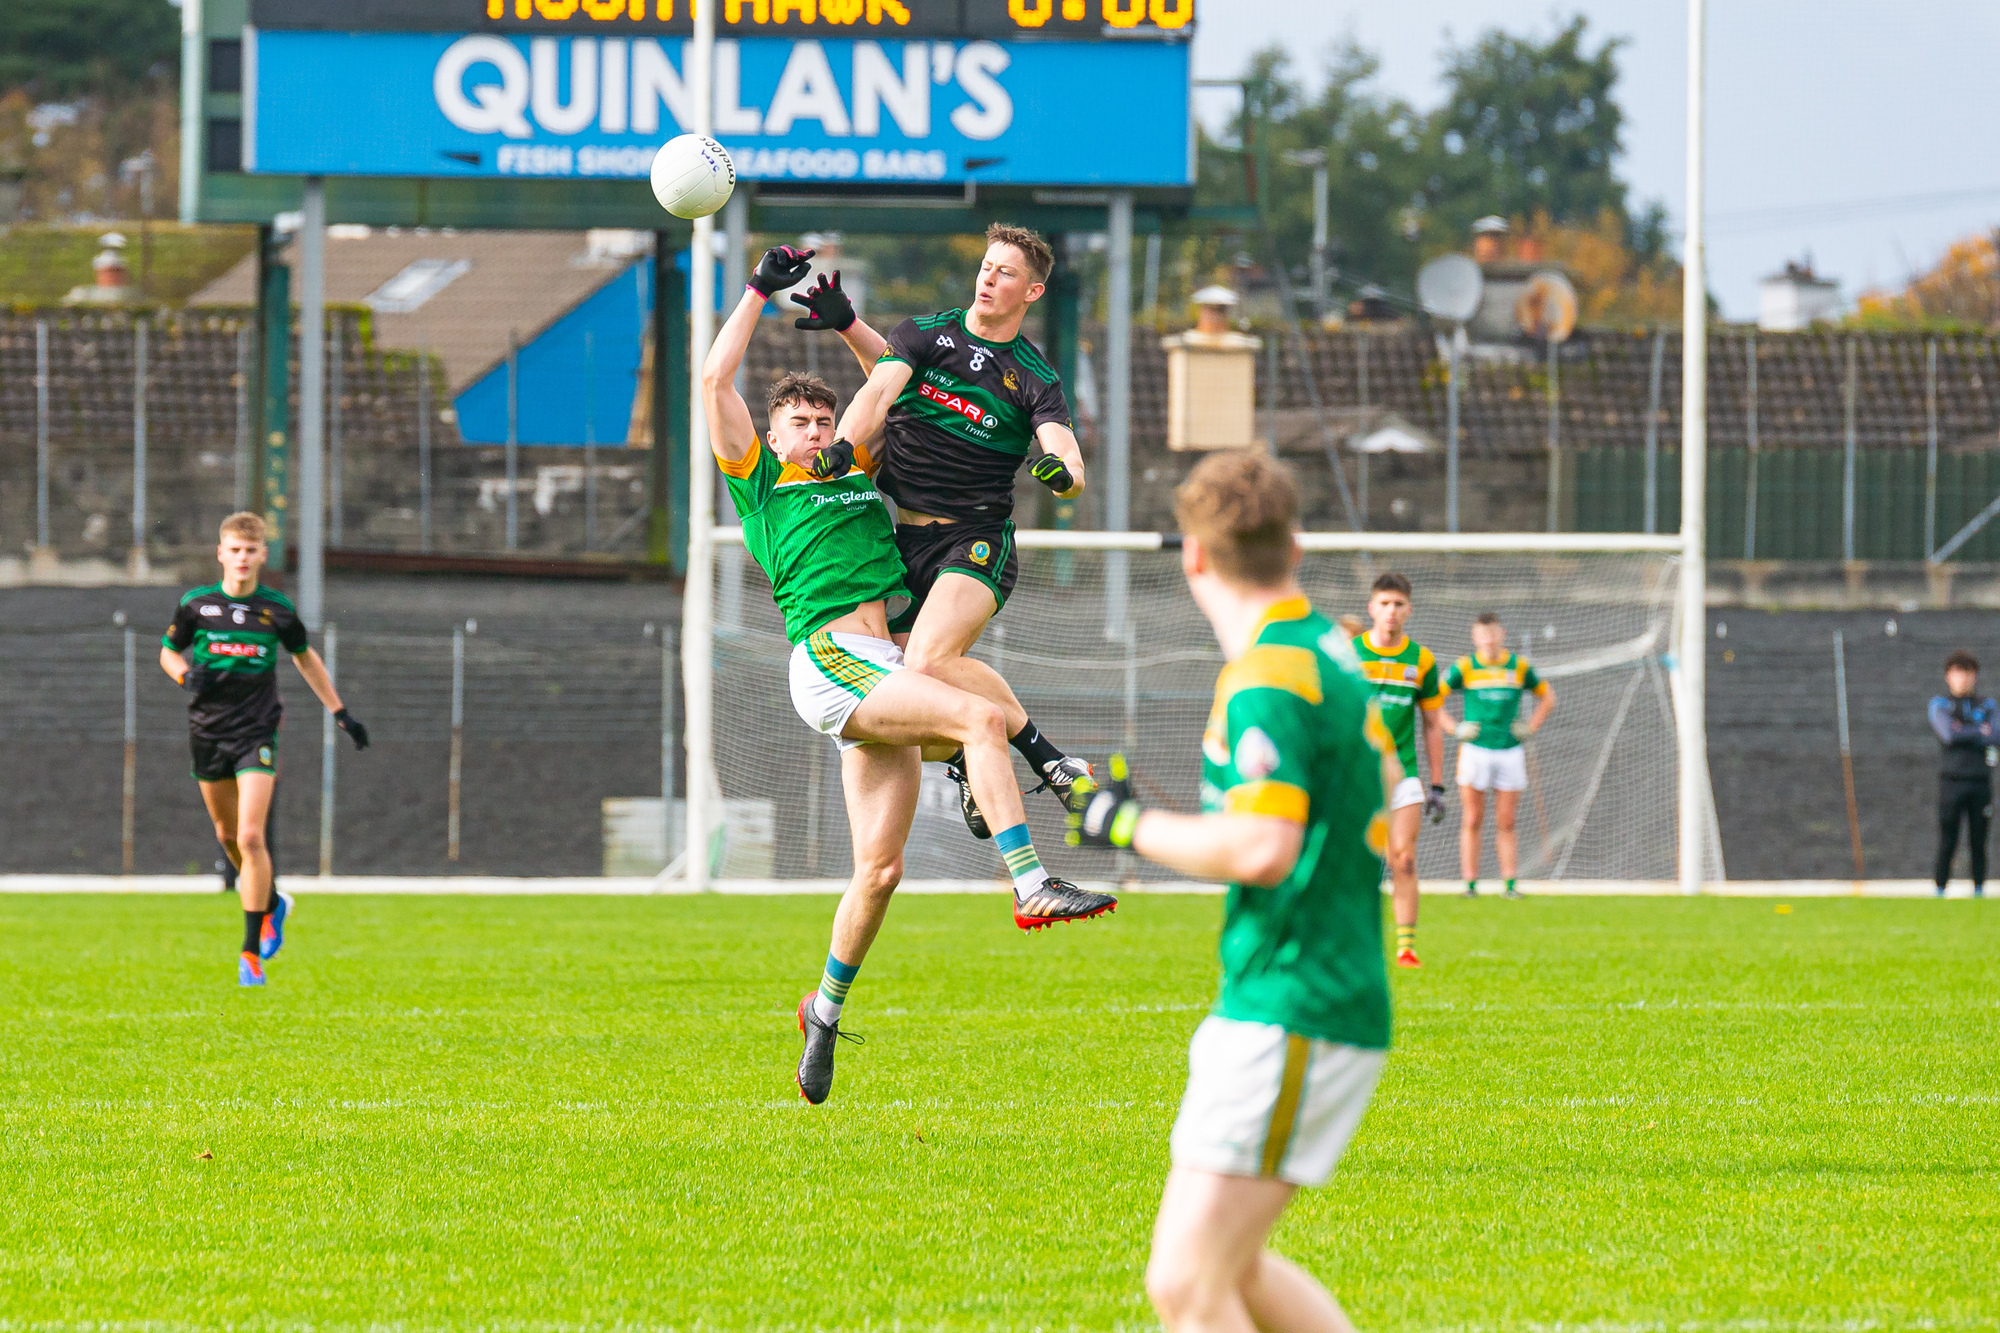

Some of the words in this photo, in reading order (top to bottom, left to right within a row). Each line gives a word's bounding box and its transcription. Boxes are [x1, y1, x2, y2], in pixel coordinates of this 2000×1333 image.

[433, 34, 1014, 140] QUINLAN'S
[497, 145, 572, 174] FISH
[730, 147, 860, 178] EAFOOD
[863, 149, 946, 180] BARS
[969, 352, 985, 372] 8
[920, 383, 981, 421] SPAR
[810, 494, 837, 507] The
